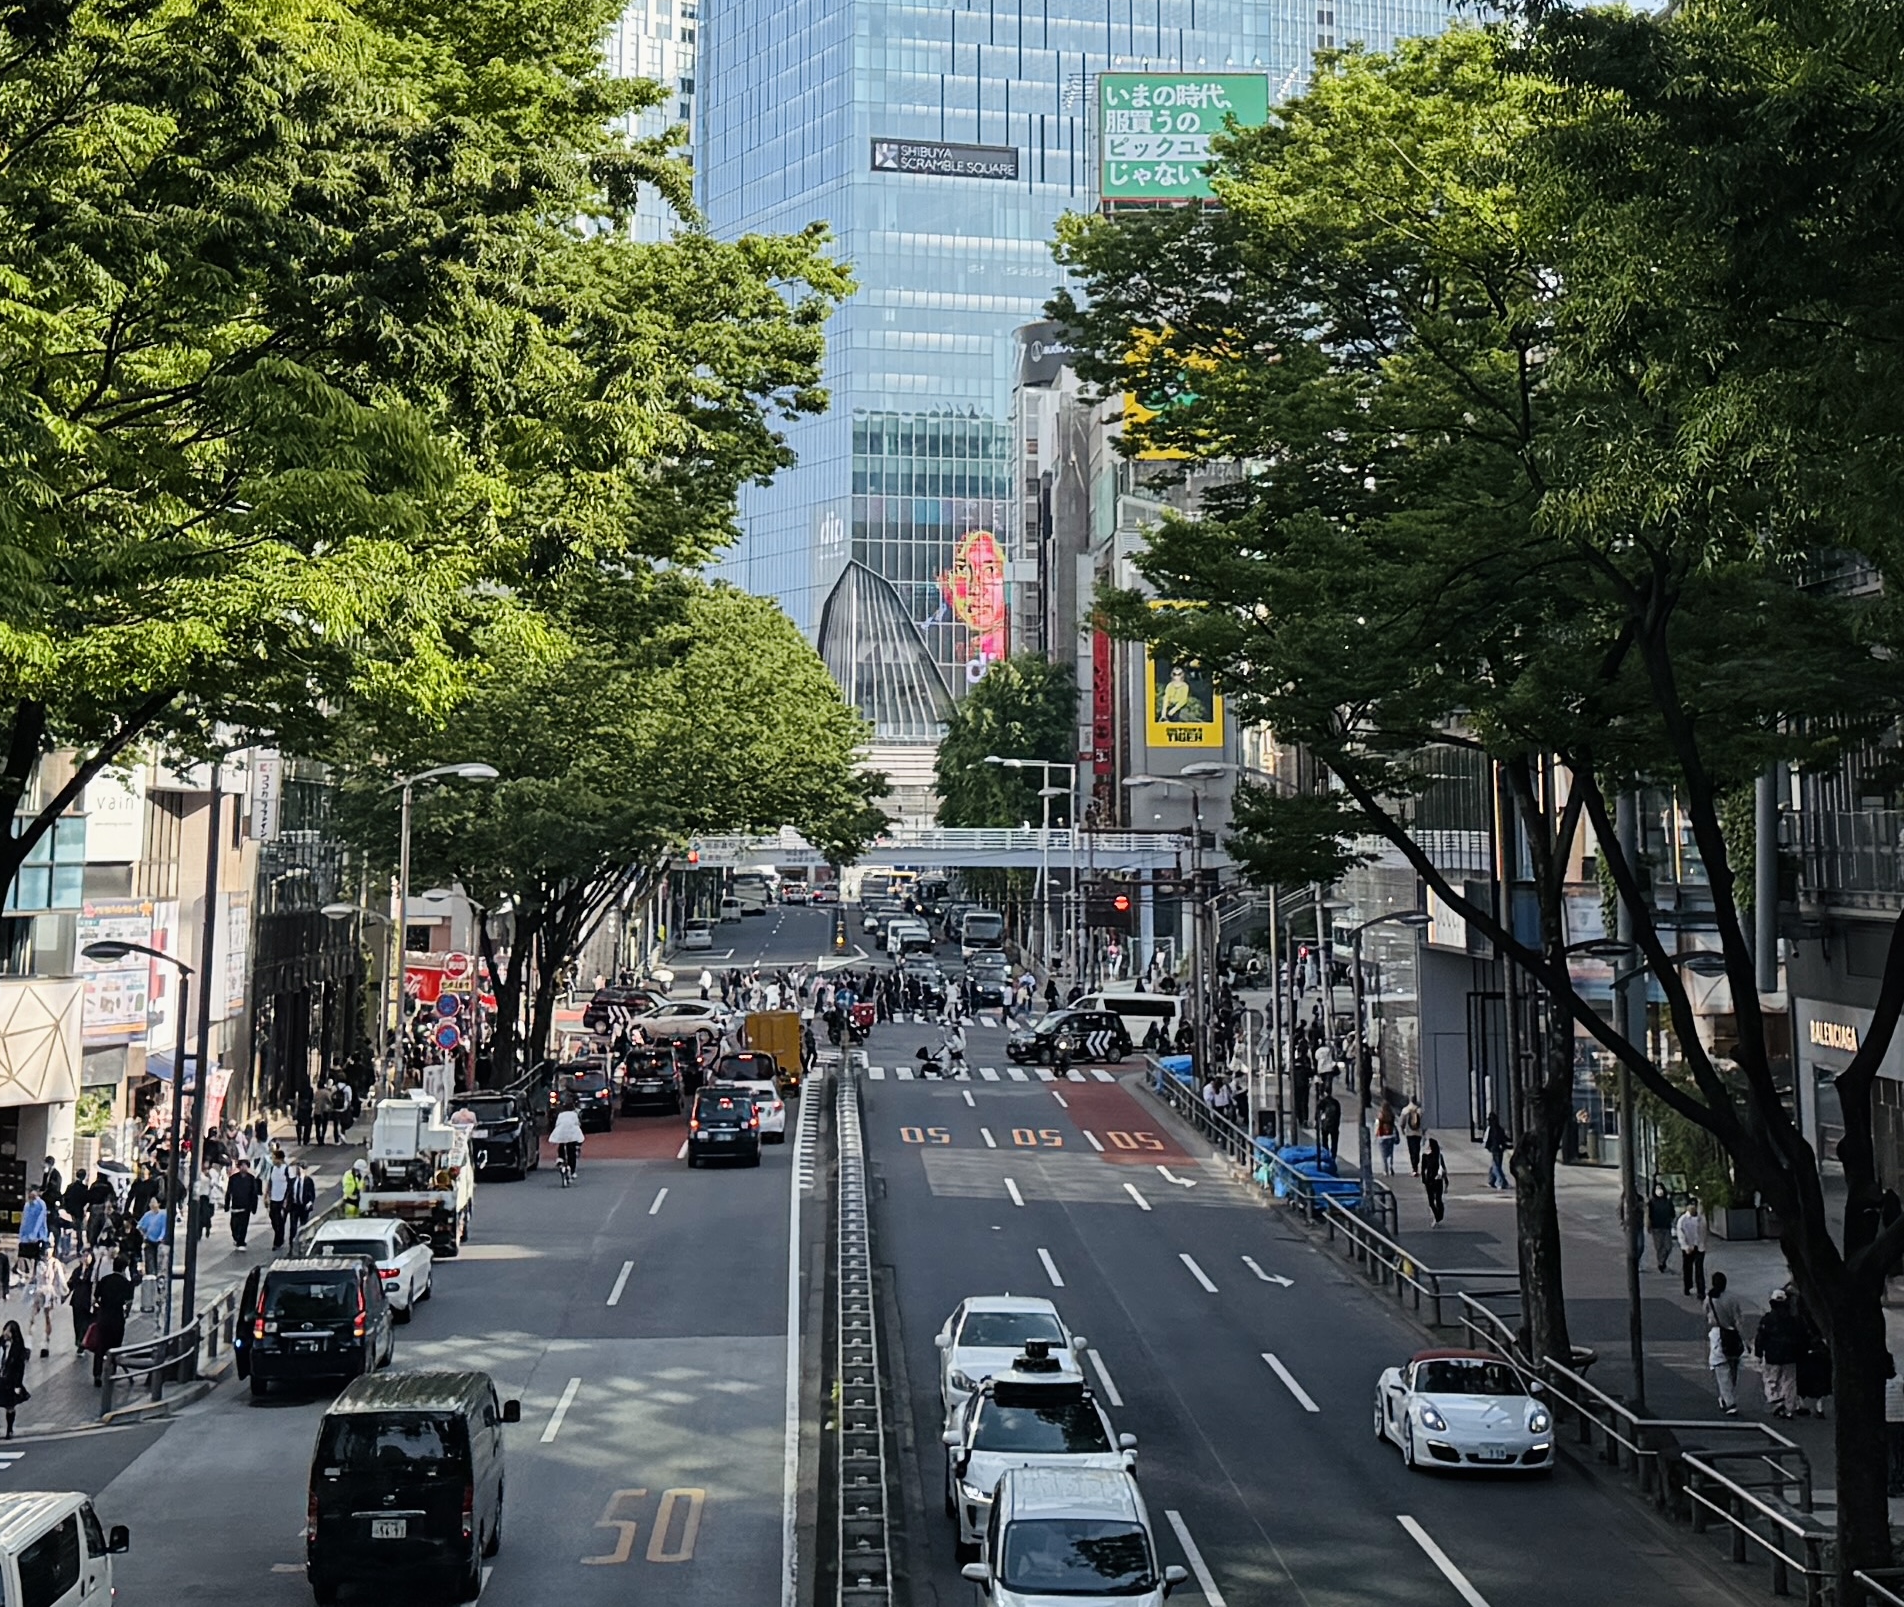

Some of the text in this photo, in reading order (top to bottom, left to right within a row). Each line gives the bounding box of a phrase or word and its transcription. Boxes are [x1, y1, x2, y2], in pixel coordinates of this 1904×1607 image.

[1106, 83, 1233, 109] いまの時代、
[1105, 109, 1201, 134] 服買うの
[900, 145, 953, 159] SHIBUYA
[900, 157, 1016, 176] SCRAMBLE SQUARE
[97, 796, 134, 811] vain
[581, 1487, 705, 1565] 50
